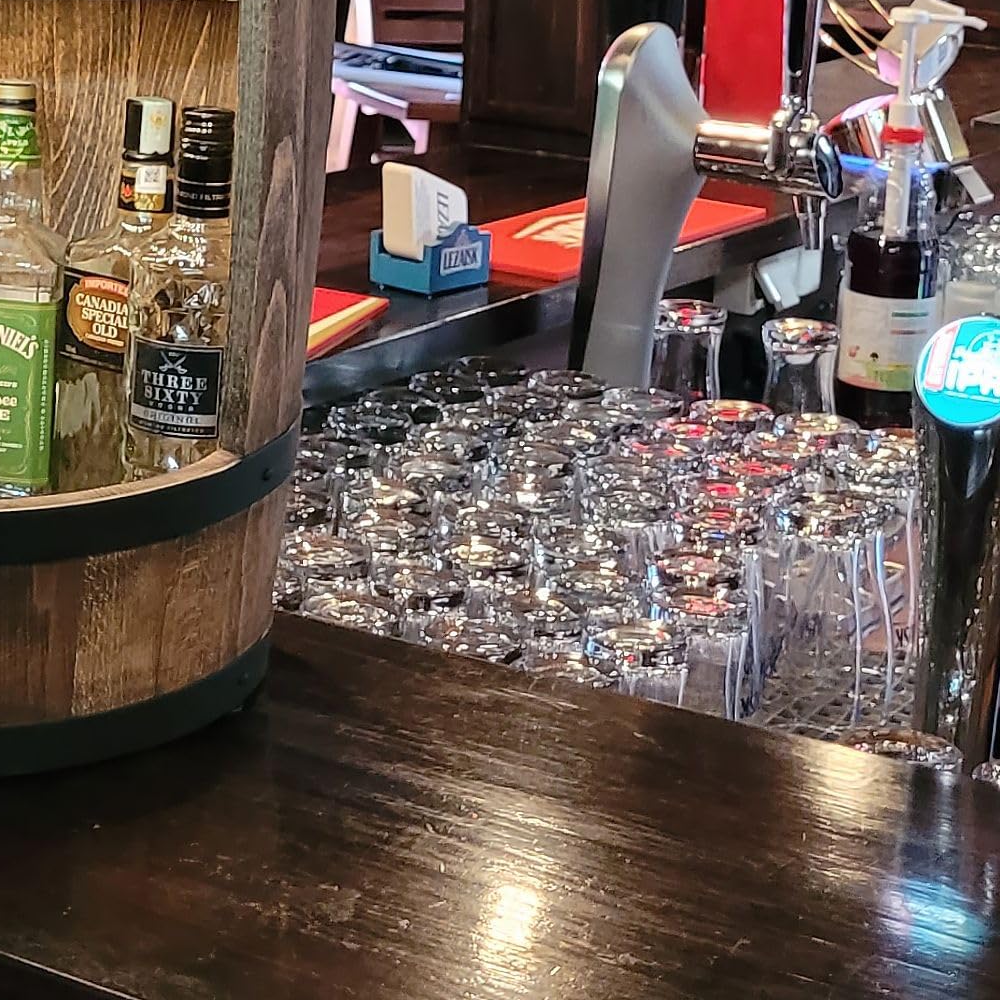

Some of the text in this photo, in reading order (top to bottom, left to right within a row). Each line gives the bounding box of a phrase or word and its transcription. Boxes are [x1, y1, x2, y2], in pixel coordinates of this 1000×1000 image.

[81, 307, 129, 329] SPECIAL
[92, 322, 118, 338] OLD
[141, 369, 208, 391] THREE
[144, 385, 204, 405] SIXTY
